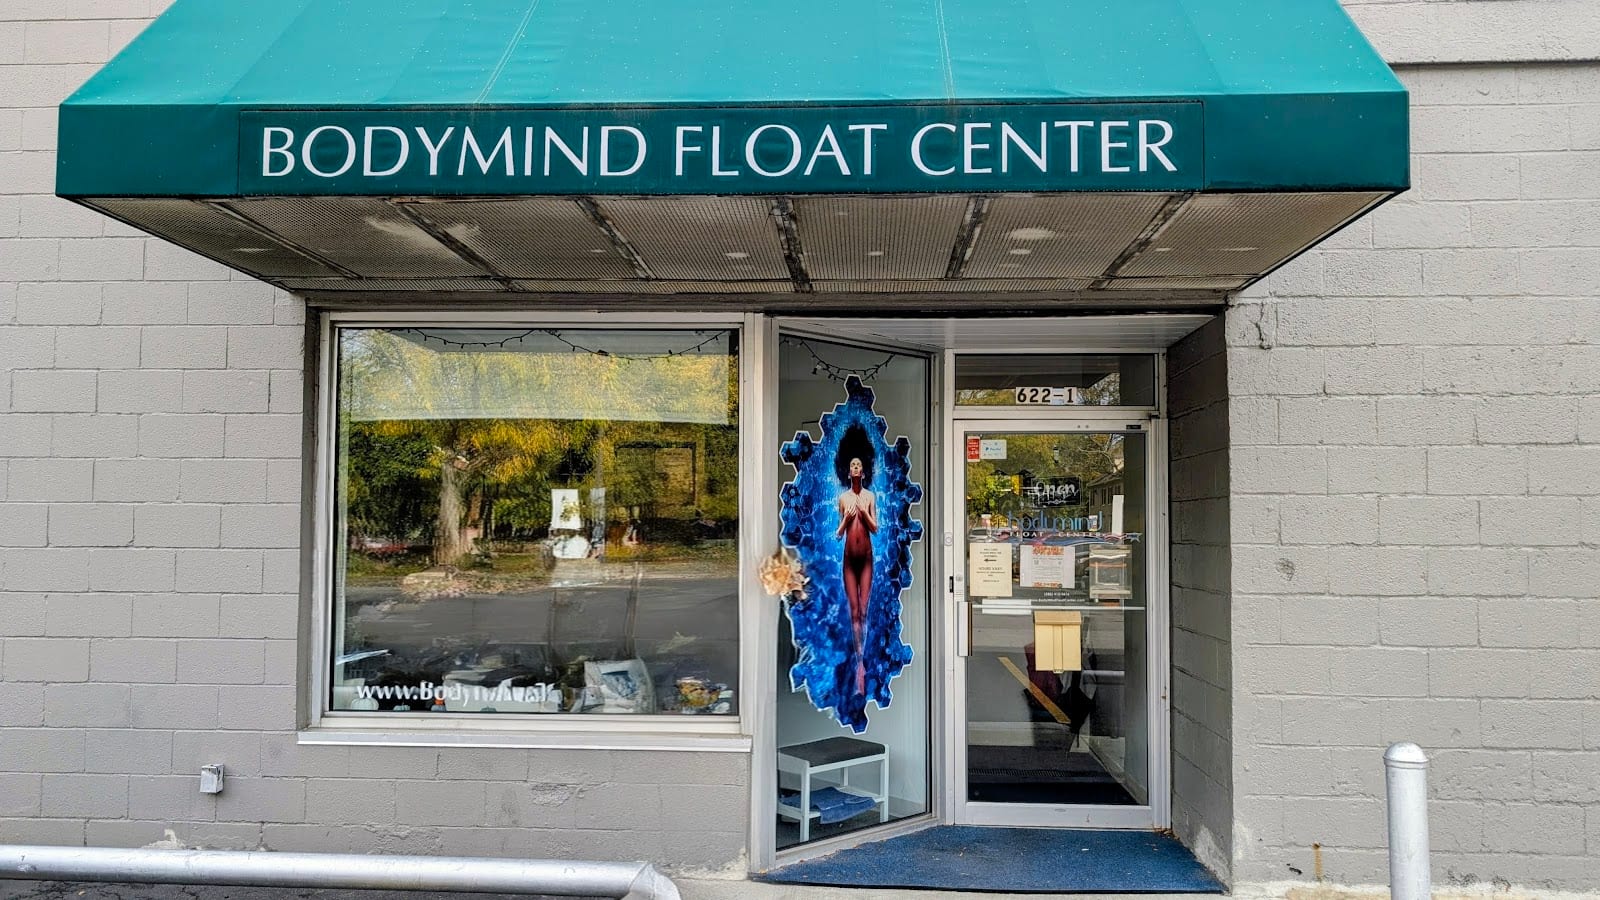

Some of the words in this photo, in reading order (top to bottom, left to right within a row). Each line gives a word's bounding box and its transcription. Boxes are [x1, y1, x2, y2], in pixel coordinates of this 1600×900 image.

[262, 125, 648, 178] BODYMIND
[675, 123, 888, 177] FLOAT
[911, 119, 1178, 176] CENTER
[1017, 388, 1074, 403] 622-1
